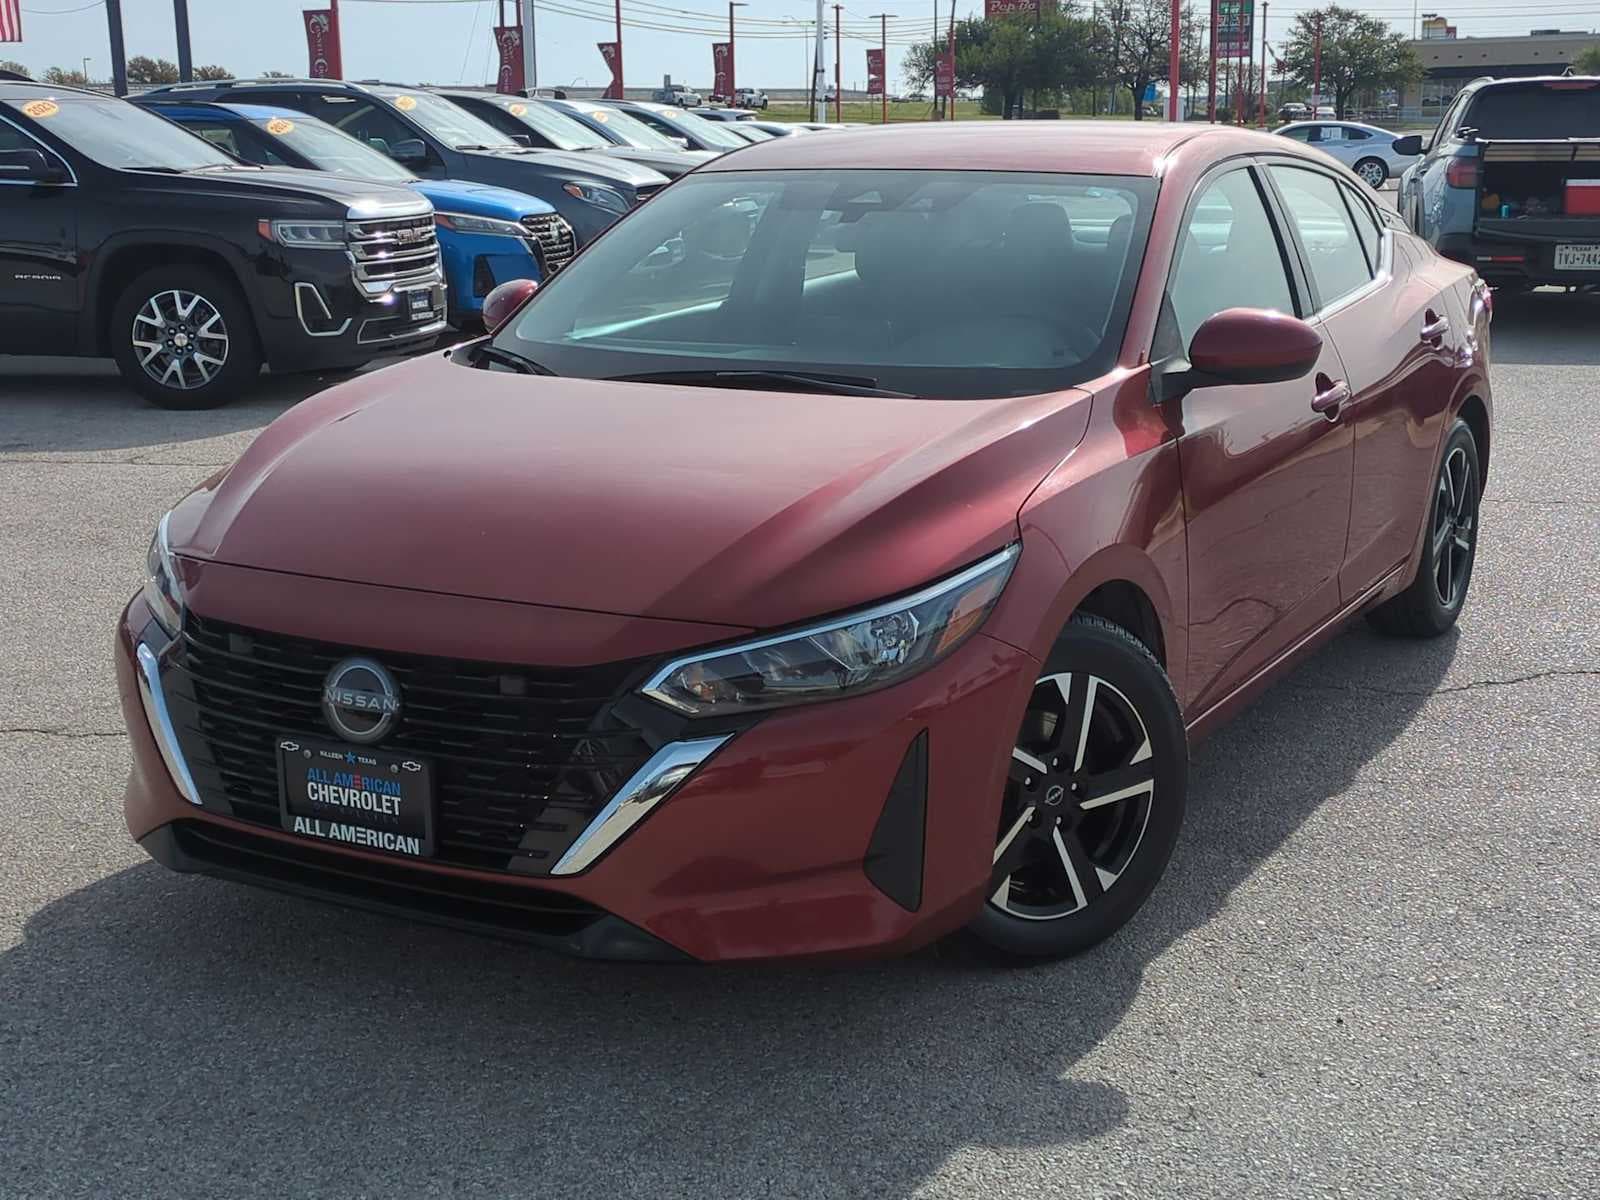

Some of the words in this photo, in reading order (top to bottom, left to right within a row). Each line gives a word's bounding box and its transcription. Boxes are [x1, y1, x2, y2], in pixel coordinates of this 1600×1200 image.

[327, 690, 397, 710] NISSAN
[357, 756, 377, 765] TEXAS
[307, 767, 331, 781] ALL
[334, 773, 400, 794] AMERICAN
[307, 781, 401, 815] CHEVROLET
[294, 816, 325, 837] ALL
[329, 823, 420, 855] AMERICAN
